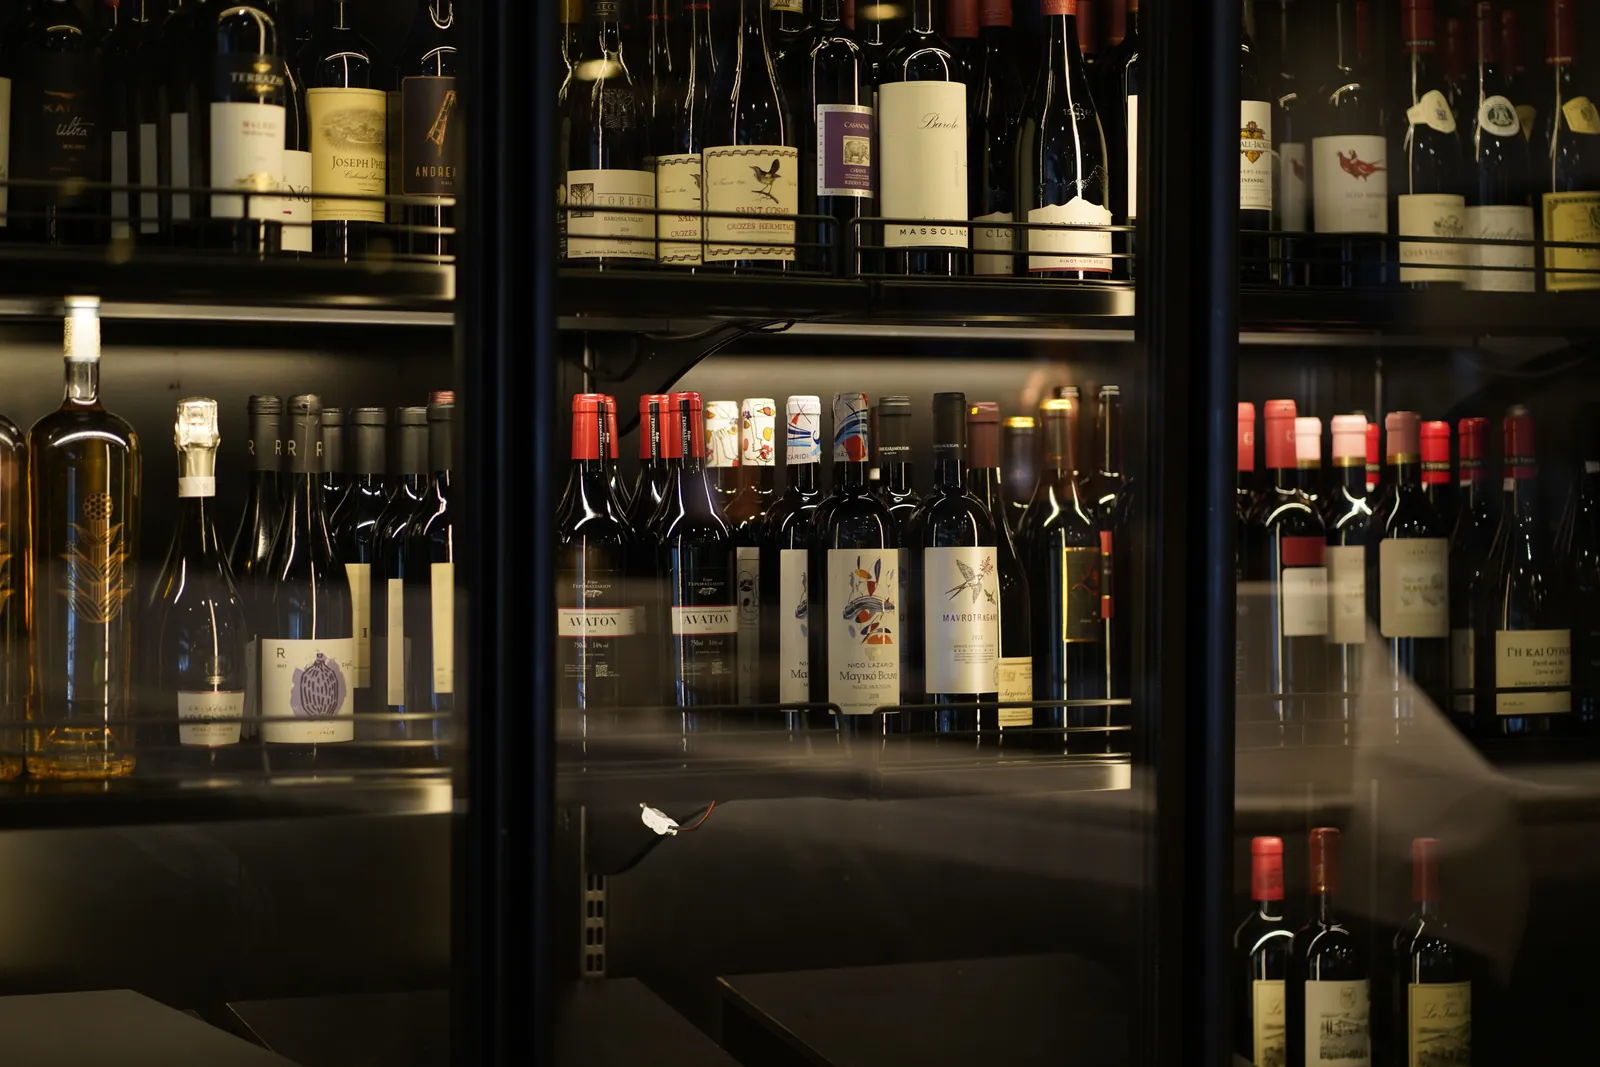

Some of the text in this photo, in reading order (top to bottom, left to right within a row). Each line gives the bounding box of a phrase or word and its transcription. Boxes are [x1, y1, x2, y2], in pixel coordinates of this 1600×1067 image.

[56, 115, 95, 137] Ultra
[917, 112, 959, 130] Barolo
[331, 155, 369, 170] JOSEPH
[670, 229, 698, 238] CROZES
[726, 222, 756, 231] CROZES
[275, 439, 282, 456] R
[287, 439, 297, 456] R
[316, 440, 323, 457] R
[683, 613, 730, 625] AVATON
[276, 647, 286, 659] R
[790, 669, 808, 679] Μα
[839, 670, 877, 684] Μαγικό
